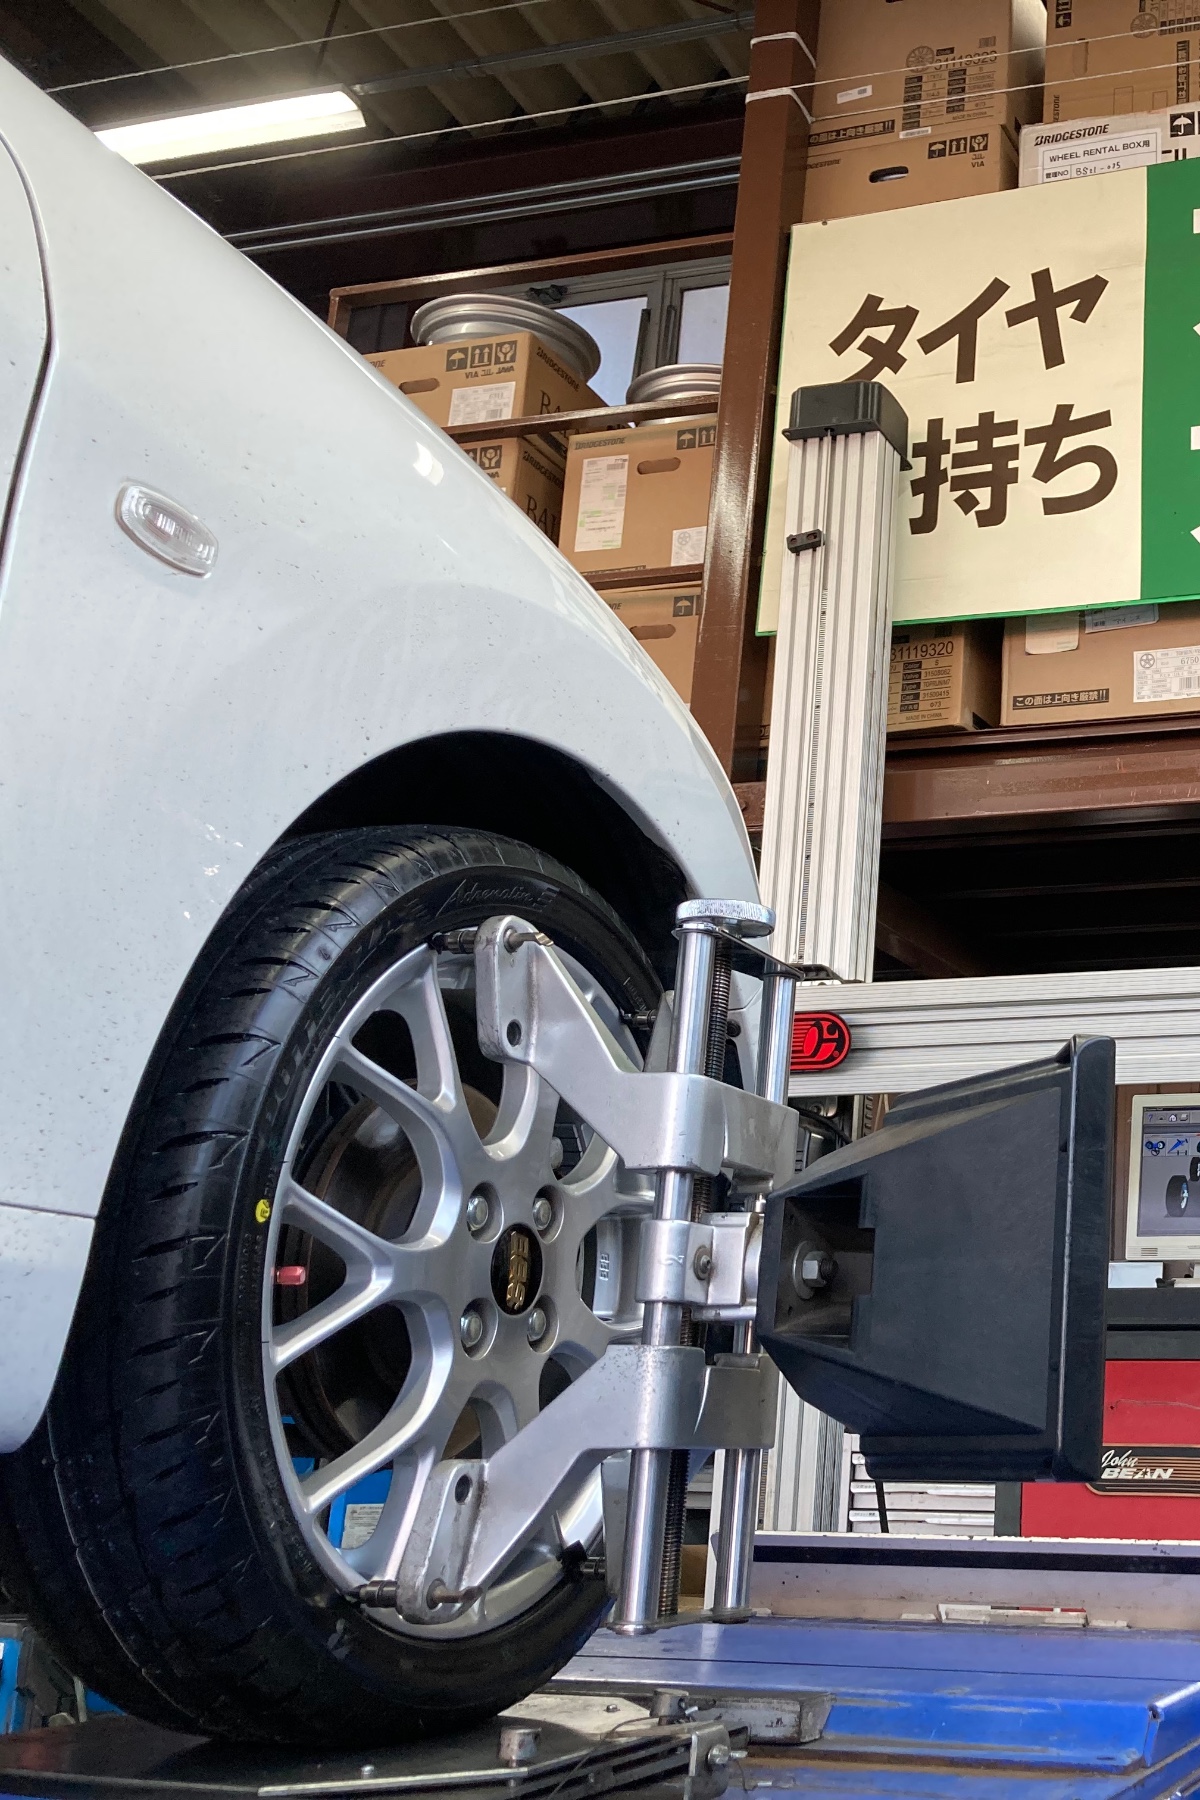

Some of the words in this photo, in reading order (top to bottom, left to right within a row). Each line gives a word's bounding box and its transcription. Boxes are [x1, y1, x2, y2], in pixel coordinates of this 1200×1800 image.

[1034, 124, 1110, 147] BRIDGESTONE
[1049, 151, 1080, 163] WHEEL
[1083, 145, 1120, 157] RENTAL
[1123, 139, 1151, 151] BOX用
[971, 160, 985, 168] VIA
[829, 267, 1109, 384] タイヤ
[465, 371, 479, 379] VIA
[536, 346, 581, 392] BRIDGESTONE
[575, 437, 626, 450] BRIDGESTONE
[890, 641, 954, 661] 31119320
[1180, 656, 1200, 665] 6750
[1015, 689, 1107, 706] この面は上向き厳禁!!
[1101, 1449, 1138, 1468] John
[1101, 1467, 1174, 1480] BEAN
